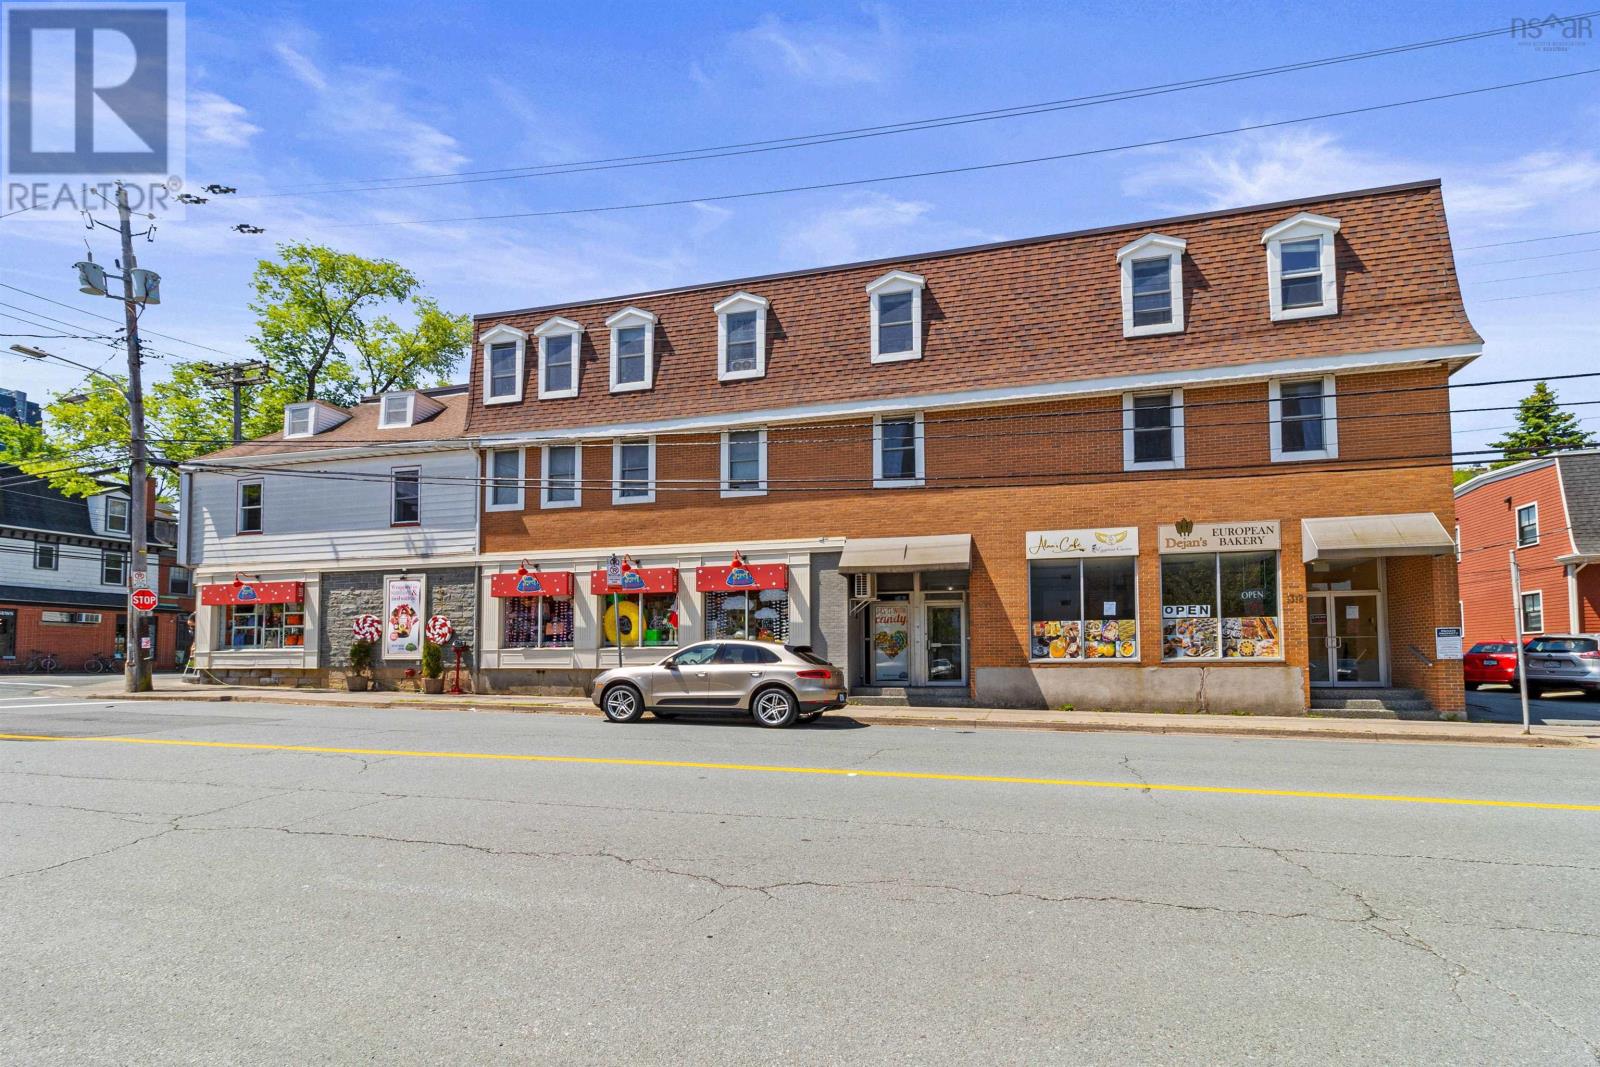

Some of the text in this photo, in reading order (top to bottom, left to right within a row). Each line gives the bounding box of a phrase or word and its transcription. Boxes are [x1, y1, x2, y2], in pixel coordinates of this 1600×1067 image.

[1212, 525, 1274, 537] EUROPEAN
[1165, 537, 1208, 549] Dejan's
[1219, 535, 1265, 546] BAKERY
[133, 596, 156, 604] STOP
[1241, 591, 1264, 599] OPEN
[1164, 606, 1209, 615] OPEN
